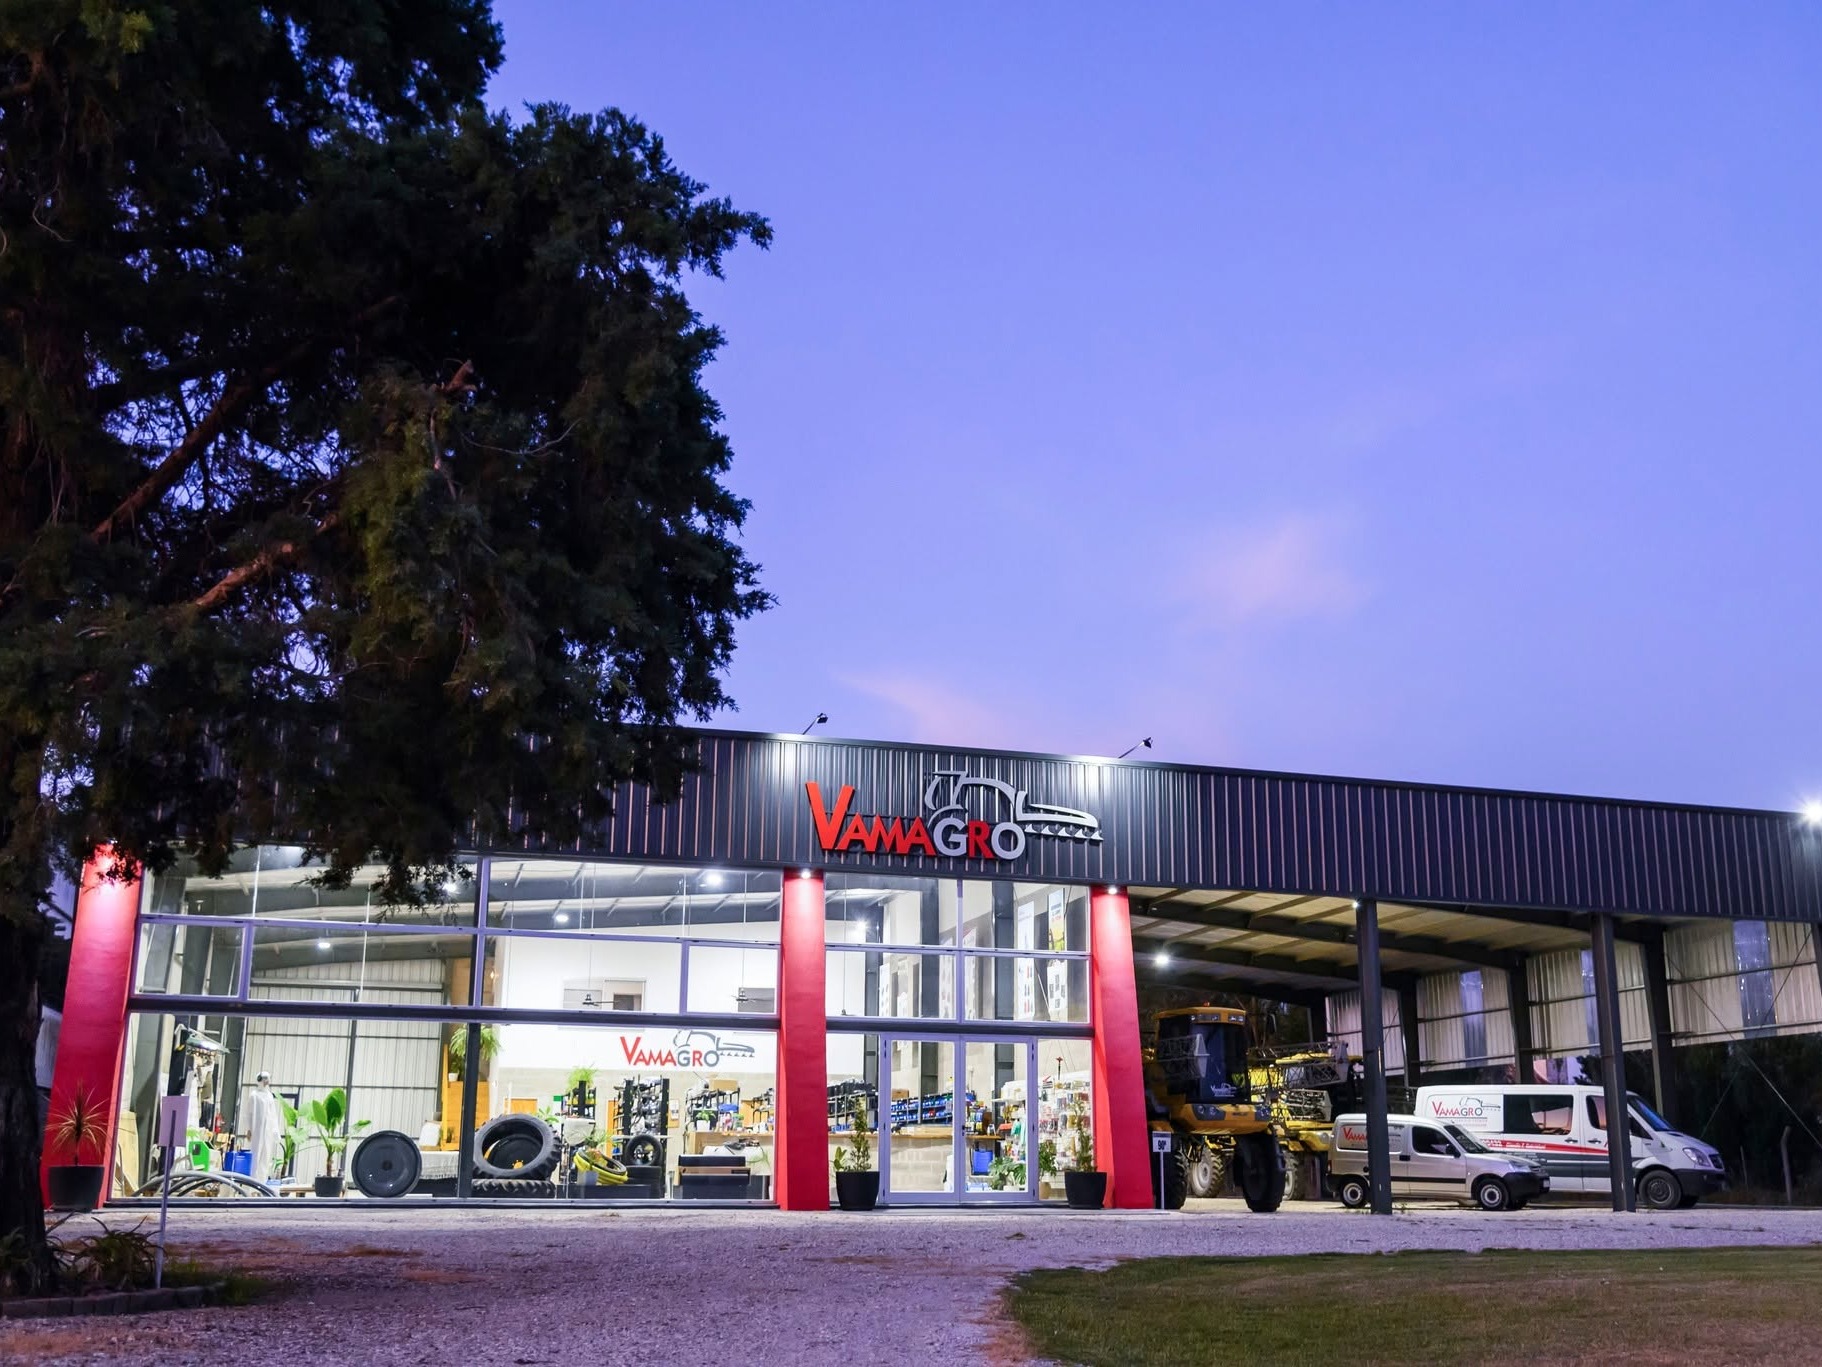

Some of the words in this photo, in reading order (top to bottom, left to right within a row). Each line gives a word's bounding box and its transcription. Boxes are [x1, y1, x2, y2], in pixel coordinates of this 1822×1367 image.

[806, 781, 1026, 860] VAMAGRO
[620, 1036, 720, 1067] VAMAGRO
[1432, 1101, 1483, 1116] VAMAGRO
[1343, 1127, 1367, 1141] VAMA
